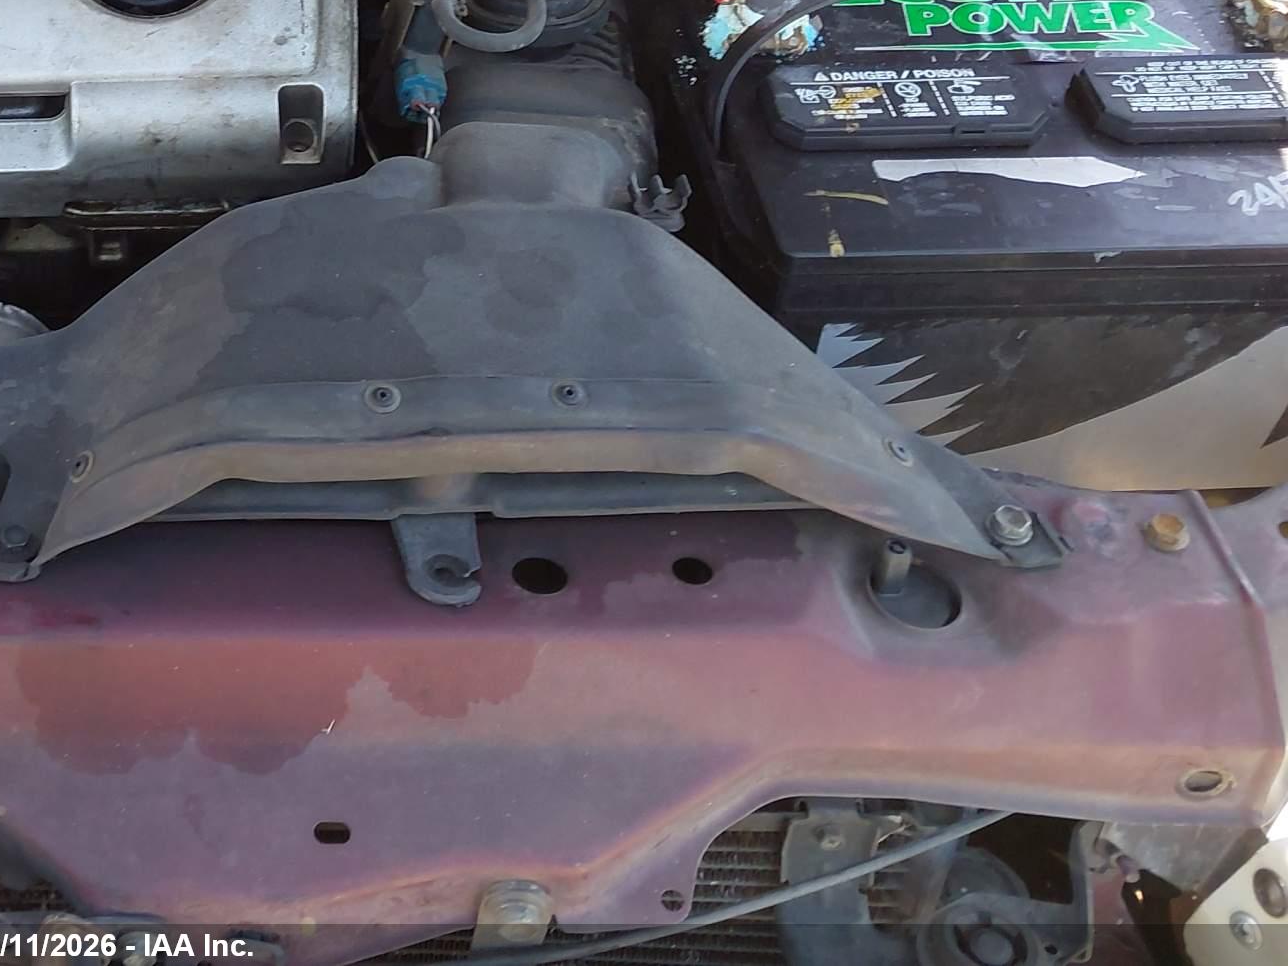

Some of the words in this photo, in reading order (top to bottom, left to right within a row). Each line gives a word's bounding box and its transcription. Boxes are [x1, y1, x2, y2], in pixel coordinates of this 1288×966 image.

[902, 0, 1156, 37] POWER
[829, 70, 899, 81] DANGER
[912, 68, 976, 78] POISON
